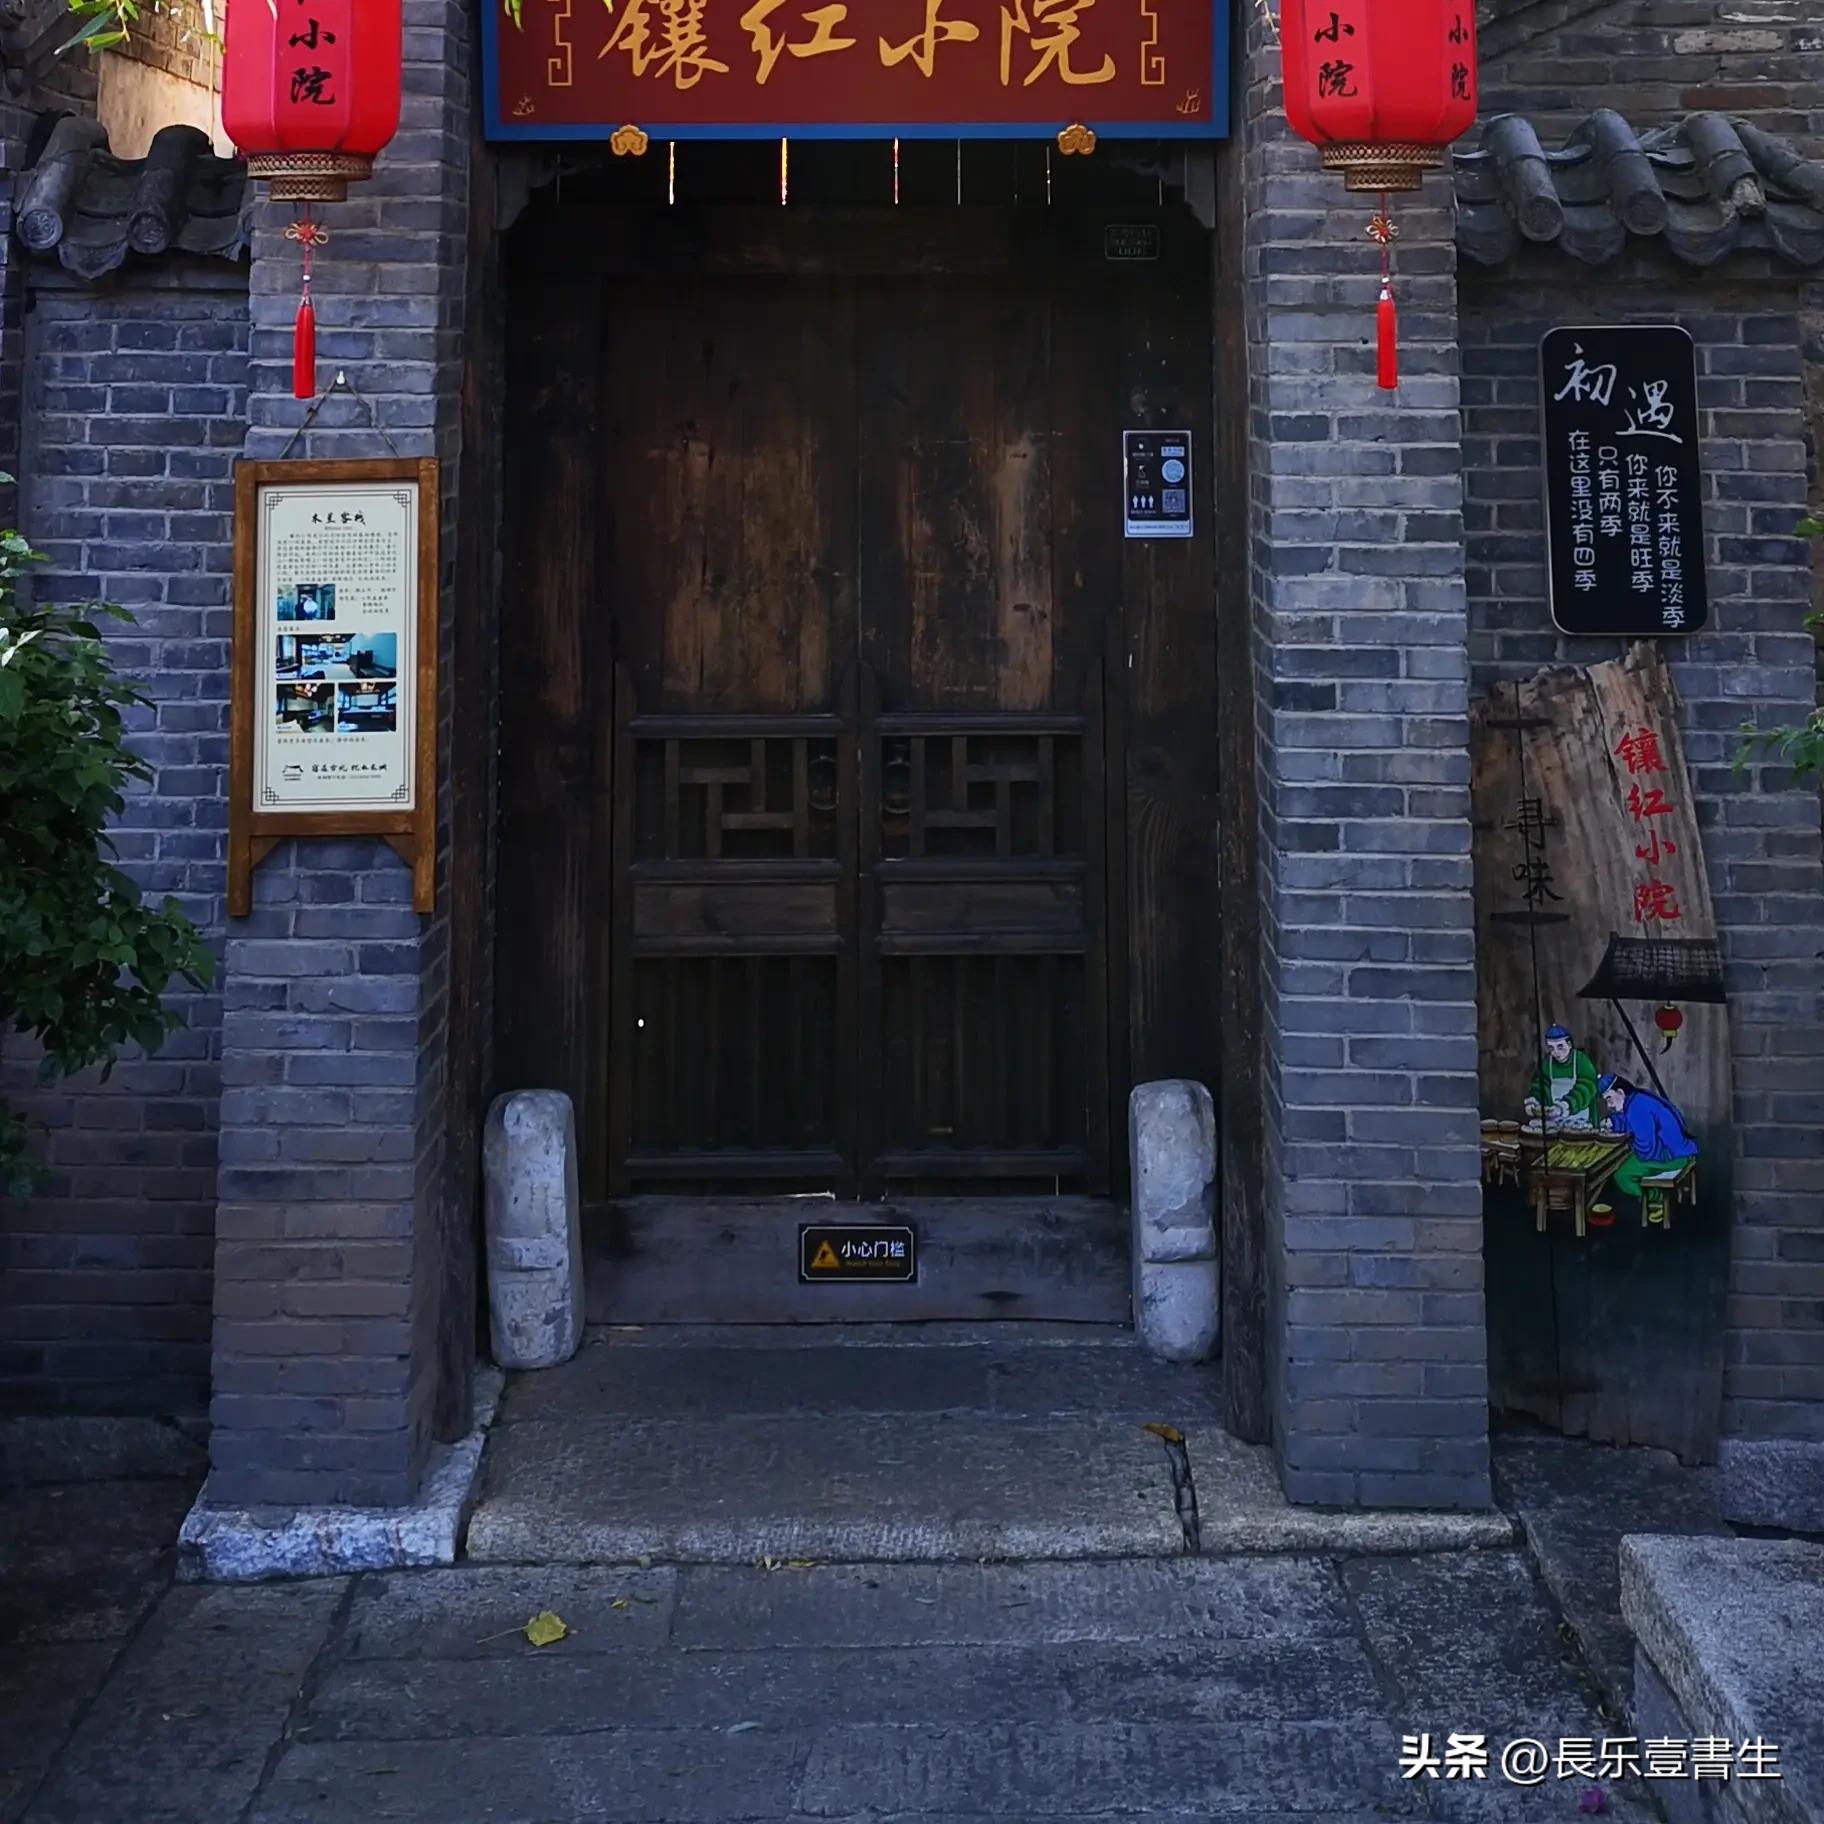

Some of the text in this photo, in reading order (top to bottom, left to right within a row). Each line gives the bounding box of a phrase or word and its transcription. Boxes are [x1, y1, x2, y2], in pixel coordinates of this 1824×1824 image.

[1553, 342, 1683, 444] 初遇
[1568, 429, 1597, 592] 在这里没有四季
[1598, 446, 1623, 537] 只有两季
[1625, 453, 1654, 593] 你来就是旺季
[1655, 465, 1685, 628] 你不来就是淡季
[1503, 797, 1564, 906] 寻味
[1613, 727, 1681, 924] 镶红小院
[841, 1240, 905, 1258] 小心门槛
